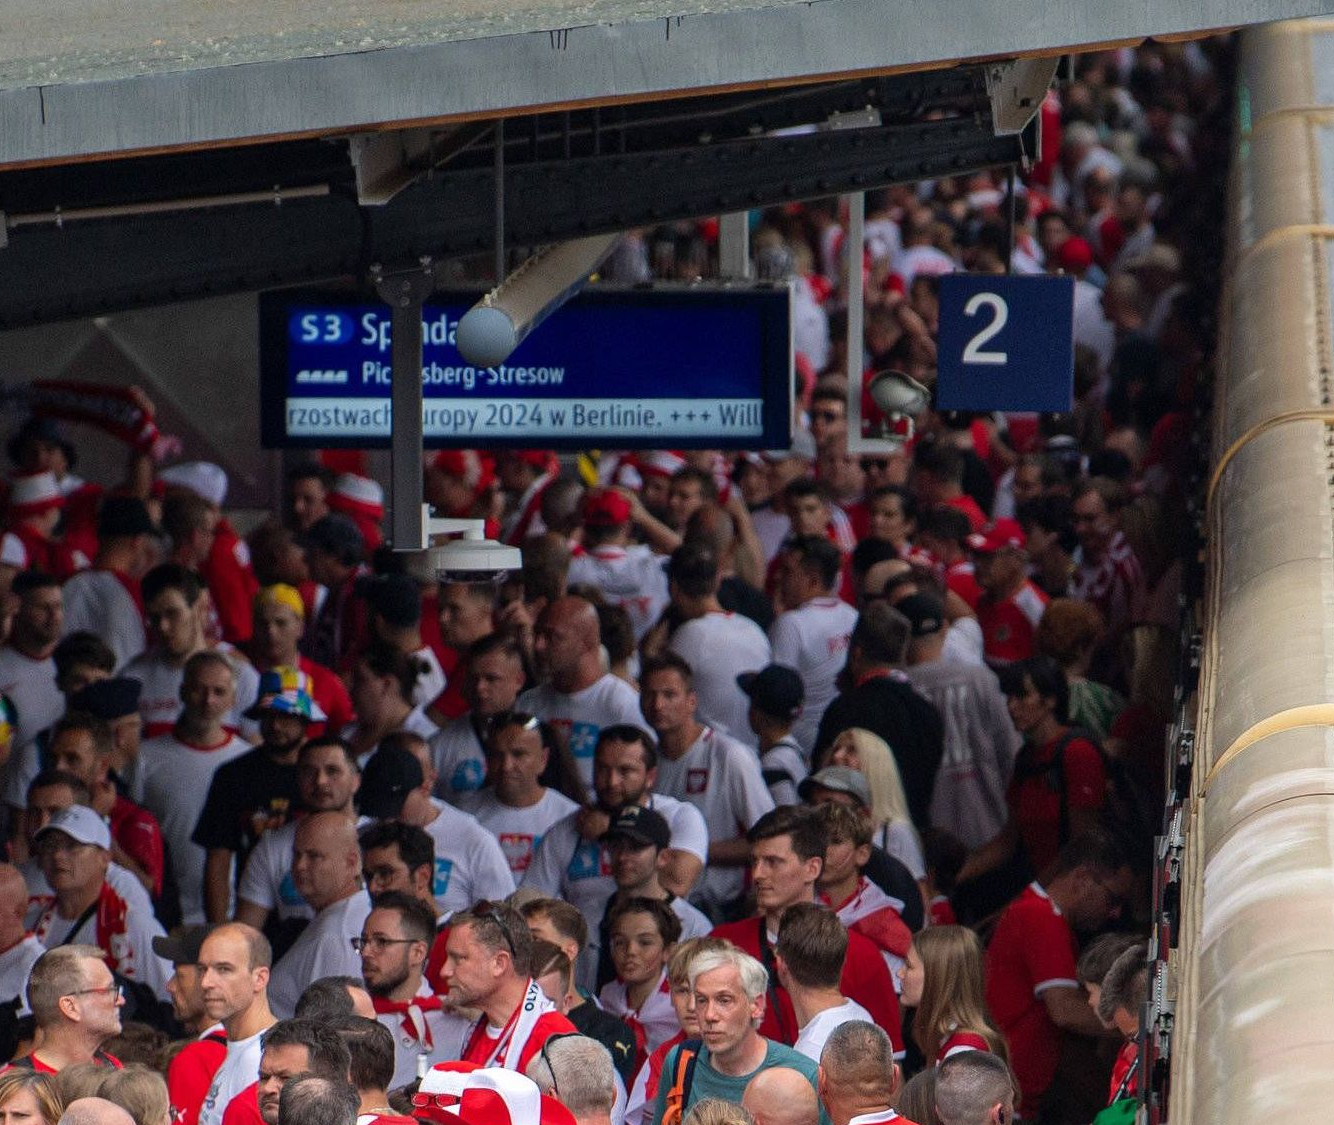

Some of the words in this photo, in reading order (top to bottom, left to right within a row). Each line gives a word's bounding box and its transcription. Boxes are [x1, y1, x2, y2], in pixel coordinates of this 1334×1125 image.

[963, 291, 1008, 365] 2
[362, 361, 565, 391] Picsberg-Stresow
[484, 403, 542, 427] 2024
[550, 408, 565, 427] w
[573, 403, 662, 427] Berlinie.
